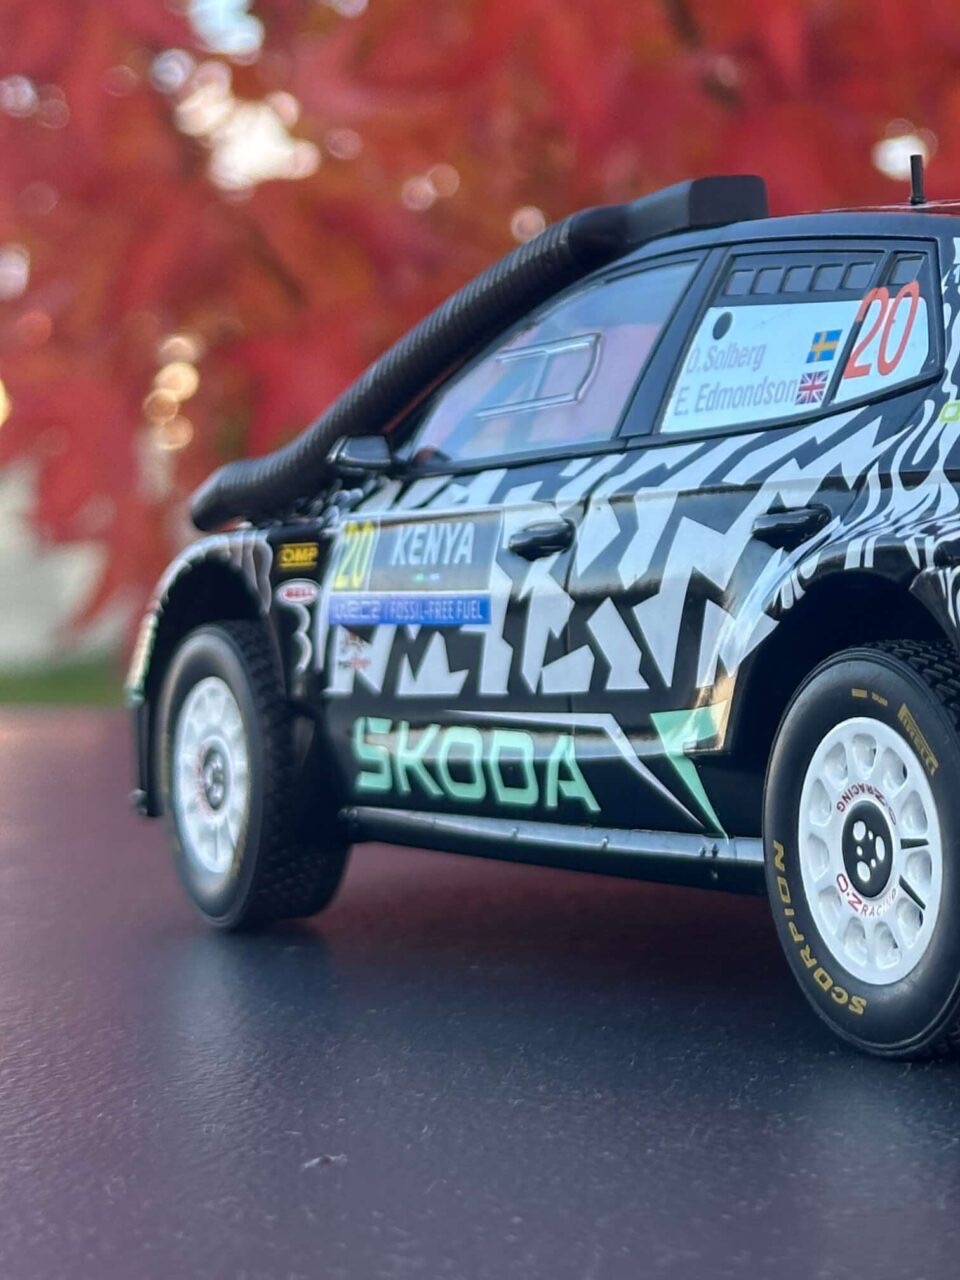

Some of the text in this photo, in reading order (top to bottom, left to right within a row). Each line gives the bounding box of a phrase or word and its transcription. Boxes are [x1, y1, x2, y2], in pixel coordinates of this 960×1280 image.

[843, 279, 919, 380] 20
[704, 343, 767, 372] Solberg
[674, 377, 798, 416] E. Edmondson
[281, 545, 318, 564] OMP
[332, 519, 376, 591] 20
[390, 521, 475, 567] KENYA
[457, 599, 483, 619] FUEL
[772, 839, 868, 1015] SCORPION
